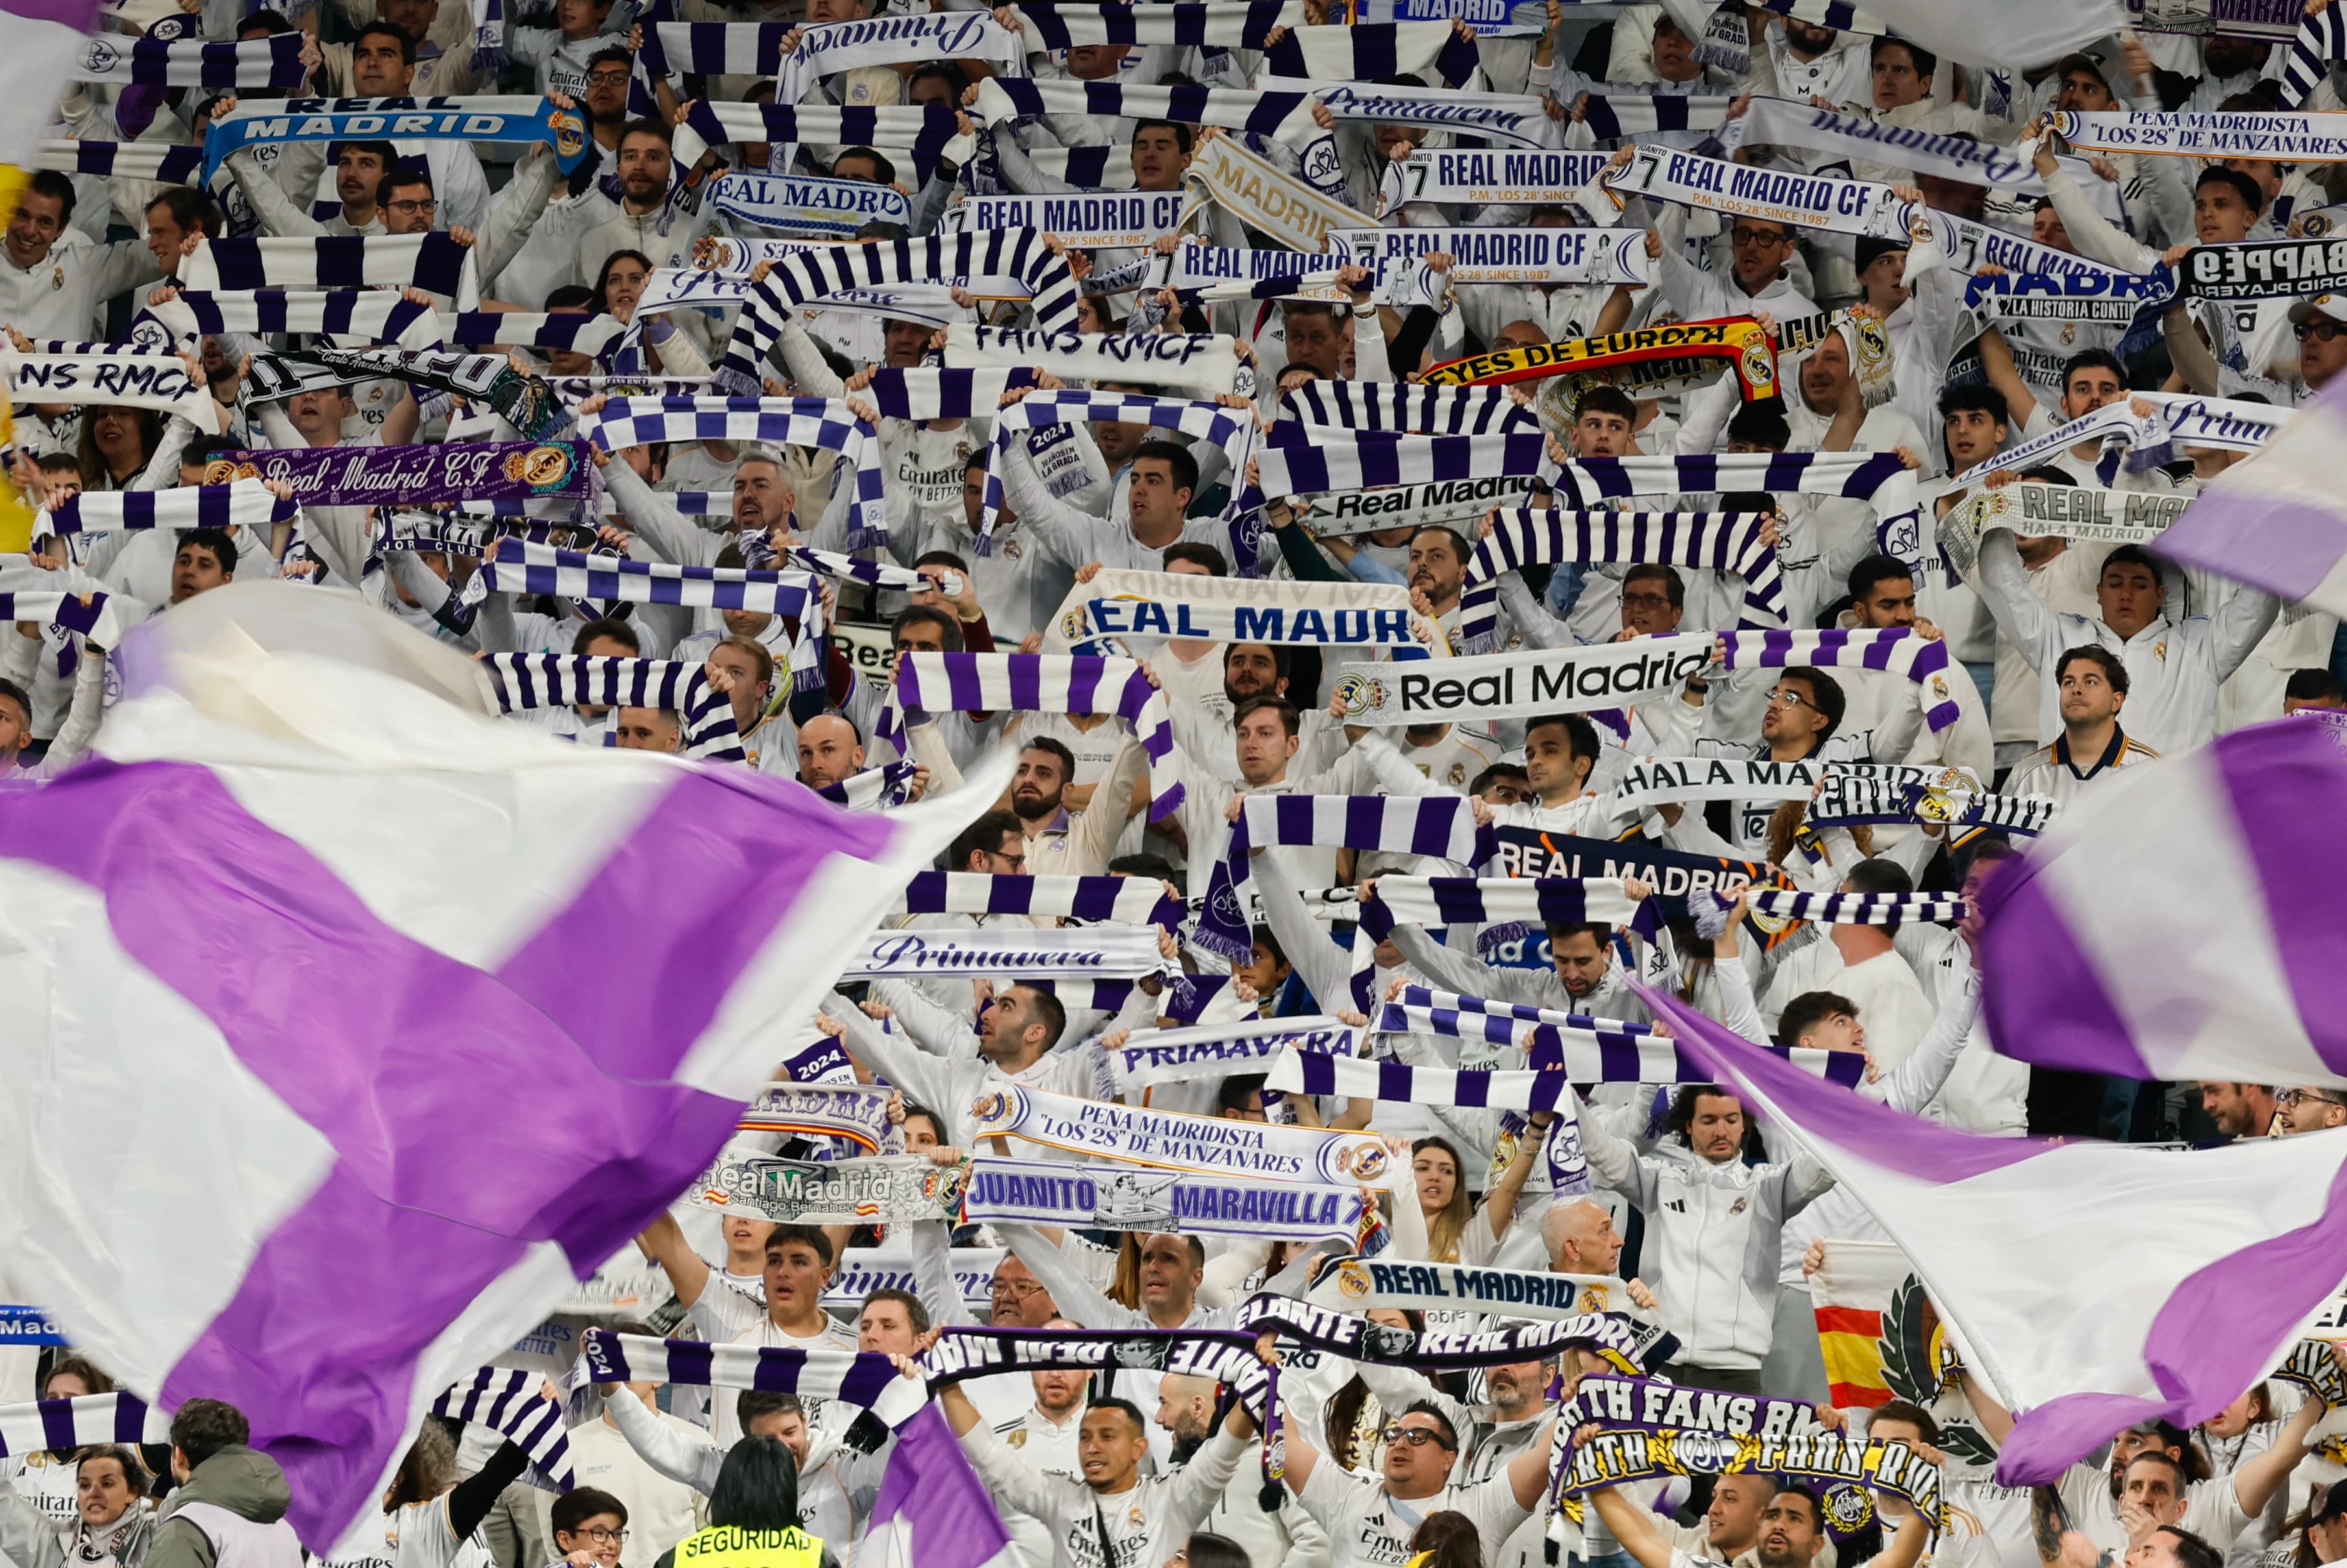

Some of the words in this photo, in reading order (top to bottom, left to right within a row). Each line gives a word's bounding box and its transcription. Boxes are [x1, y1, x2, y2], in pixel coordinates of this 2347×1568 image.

[549, 69, 587, 86] Emirat
[243, 113, 505, 140] MADRID
[2178, 130, 2204, 147] DE
[2186, 114, 2309, 133] MADRIDISTA
[1407, 153, 1432, 163] UANITO
[1407, 163, 1429, 199] 7
[1439, 154, 1498, 186] REAL
[1638, 154, 1661, 191] 7
[1667, 154, 1726, 193] REAL
[1730, 167, 1832, 212] MADRID
[1837, 185, 1871, 217] CF
[1043, 198, 1146, 232] MADRID
[1765, 206, 1798, 221] SINCE
[1802, 214, 1830, 227] 1987
[1081, 235, 1116, 245] SINCE
[1120, 234, 1147, 244] 1987
[1351, 233, 1380, 243] JUANITO
[1451, 234, 1549, 266] MADRID
[1556, 233, 1587, 266] CF
[1153, 252, 1176, 288] 7
[1185, 245, 1242, 278] REAL
[1486, 270, 1521, 280] SINCE
[1523, 270, 1550, 280] 1987
[1964, 273, 2144, 309] MADR
[2013, 299, 2028, 315] LA
[2031, 299, 2089, 318] HISTORIA
[2091, 300, 2139, 320] CONTIN
[322, 349, 349, 364] Carlo
[1098, 331, 1213, 365] RMCF
[1425, 352, 1515, 385] EYES
[1525, 341, 1575, 367] DE
[1032, 423, 1067, 448] 2024
[267, 457, 323, 493] Real
[330, 456, 436, 491] Madrid
[1051, 454, 1081, 476] GRADA
[1335, 487, 1414, 519] Real
[2021, 485, 2113, 525] REAL
[383, 541, 416, 551] JOR
[435, 541, 478, 557] CLUB
[2076, 525, 2145, 541] MADRID
[1087, 597, 1210, 637] EAL
[1235, 606, 1410, 644] MADR
[1401, 667, 1513, 712] Real
[1532, 646, 1712, 702] Madrid
[865, 934, 1109, 972] Primavera
[798, 1049, 841, 1081] 2024
[1080, 1104, 1132, 1129] PEÑA
[1136, 1115, 1264, 1149] MADRIDISTA
[1040, 1112, 1087, 1138] "LOS
[1089, 1127, 1126, 1147] 28"
[1127, 1133, 1155, 1154] DE
[1159, 1140, 1304, 1174] MANZANARES
[728, 1191, 787, 1212] Santiago
[790, 1202, 856, 1213] Bernabeu
[775, 1170, 893, 1202] Madrid
[968, 1172, 1098, 1212] JUANITO
[1171, 1184, 1343, 1227] MARAVILLA
[1369, 1264, 1450, 1297] REAL
[1455, 1268, 1576, 1309] MADRID
[1418, 1327, 1511, 1354] REAL
[1641, 1384, 1756, 1435] FANS
[685, 1529, 811, 1558] SEGURIDAD
